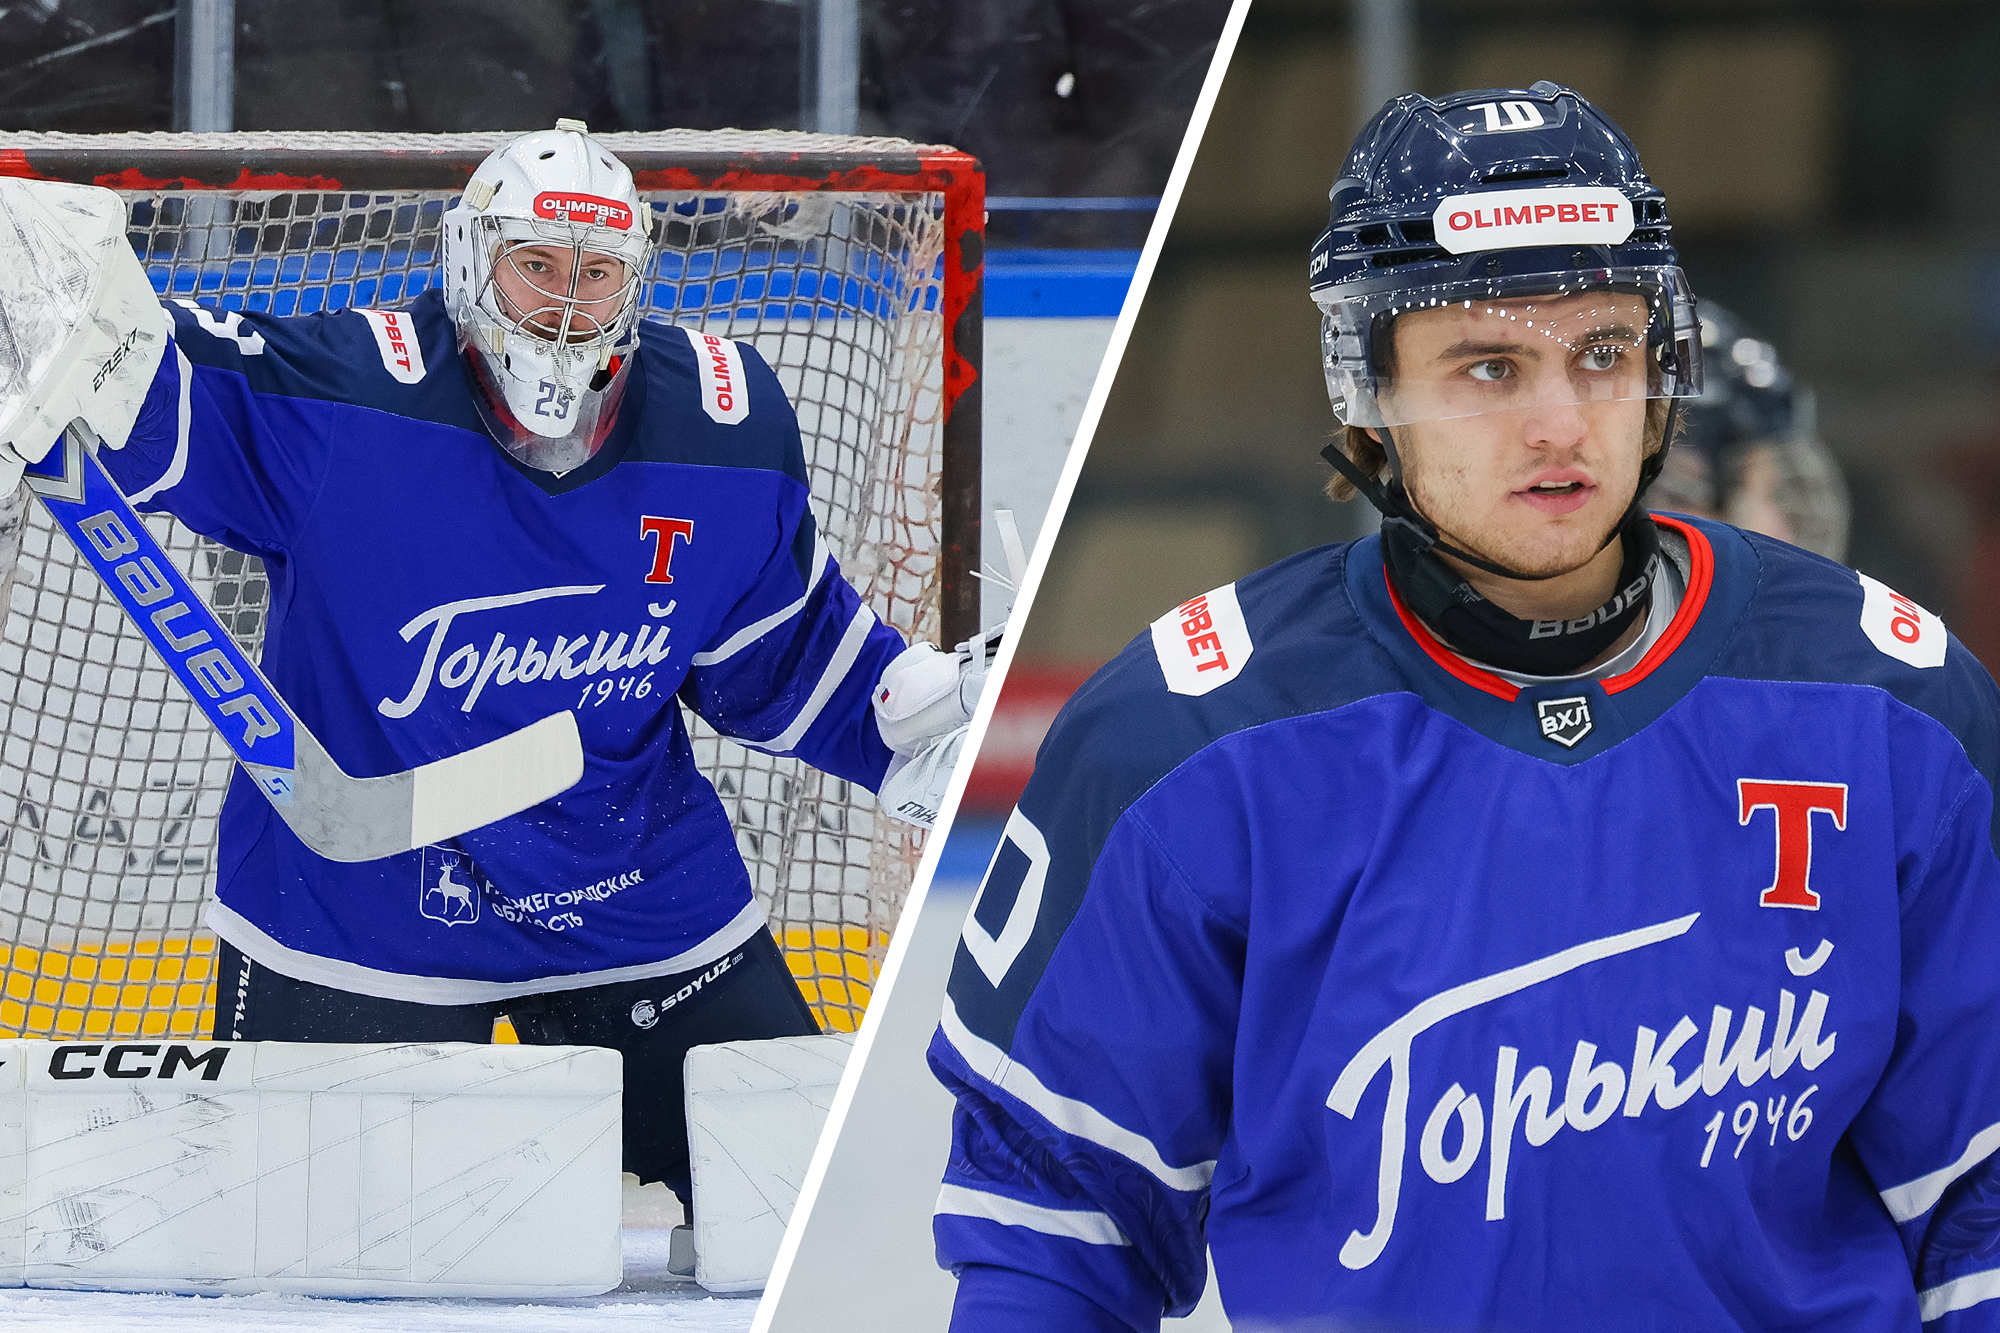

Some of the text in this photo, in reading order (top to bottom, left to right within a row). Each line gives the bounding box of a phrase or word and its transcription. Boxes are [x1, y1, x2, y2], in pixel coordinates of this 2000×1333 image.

[1466, 101, 1545, 132] 70
[541, 198, 629, 221] OLIMPBET
[1448, 203, 1619, 231] OLIMPBET
[1310, 250, 1329, 279] CCM
[376, 310, 411, 372] PBET
[703, 333, 733, 411] OLIMPB
[1333, 401, 1346, 412] CCM
[76, 509, 281, 749] BAUER
[377, 584, 677, 719] Горький
[577, 672, 655, 710] 1946
[1541, 704, 1590, 735] ВХЛ
[661, 956, 731, 1012] SOYUZ
[48, 1044, 231, 1081] CCM
[1326, 912, 1837, 1270] Горький
[1699, 1084, 1819, 1168] 1946
